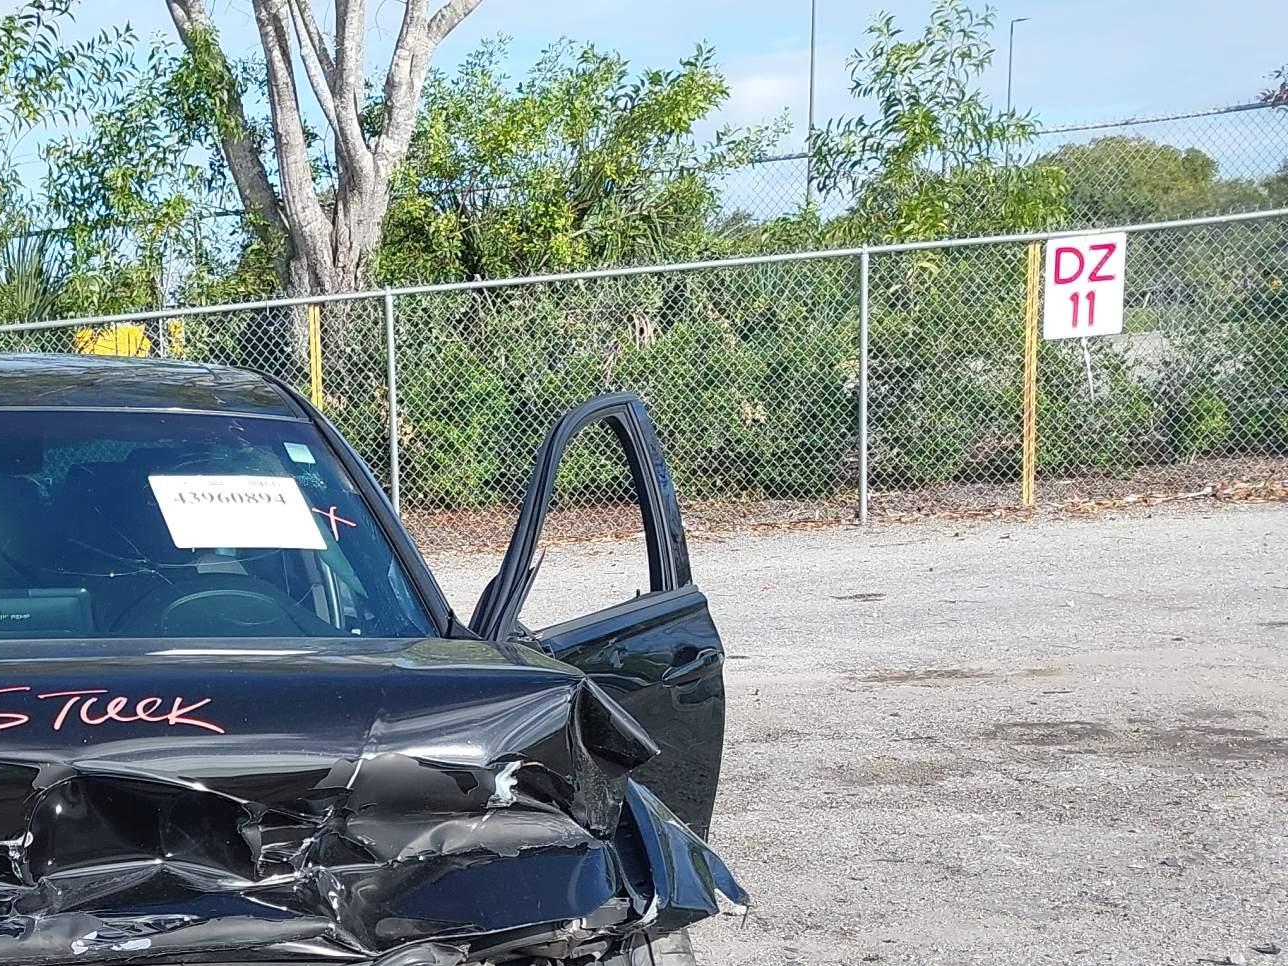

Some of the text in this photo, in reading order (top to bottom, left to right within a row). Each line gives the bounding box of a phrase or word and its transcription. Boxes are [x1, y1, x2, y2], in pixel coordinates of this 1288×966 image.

[1054, 243, 1117, 285] DZ
[1069, 290, 1096, 328] 11
[173, 491, 288, 505] 43960894
